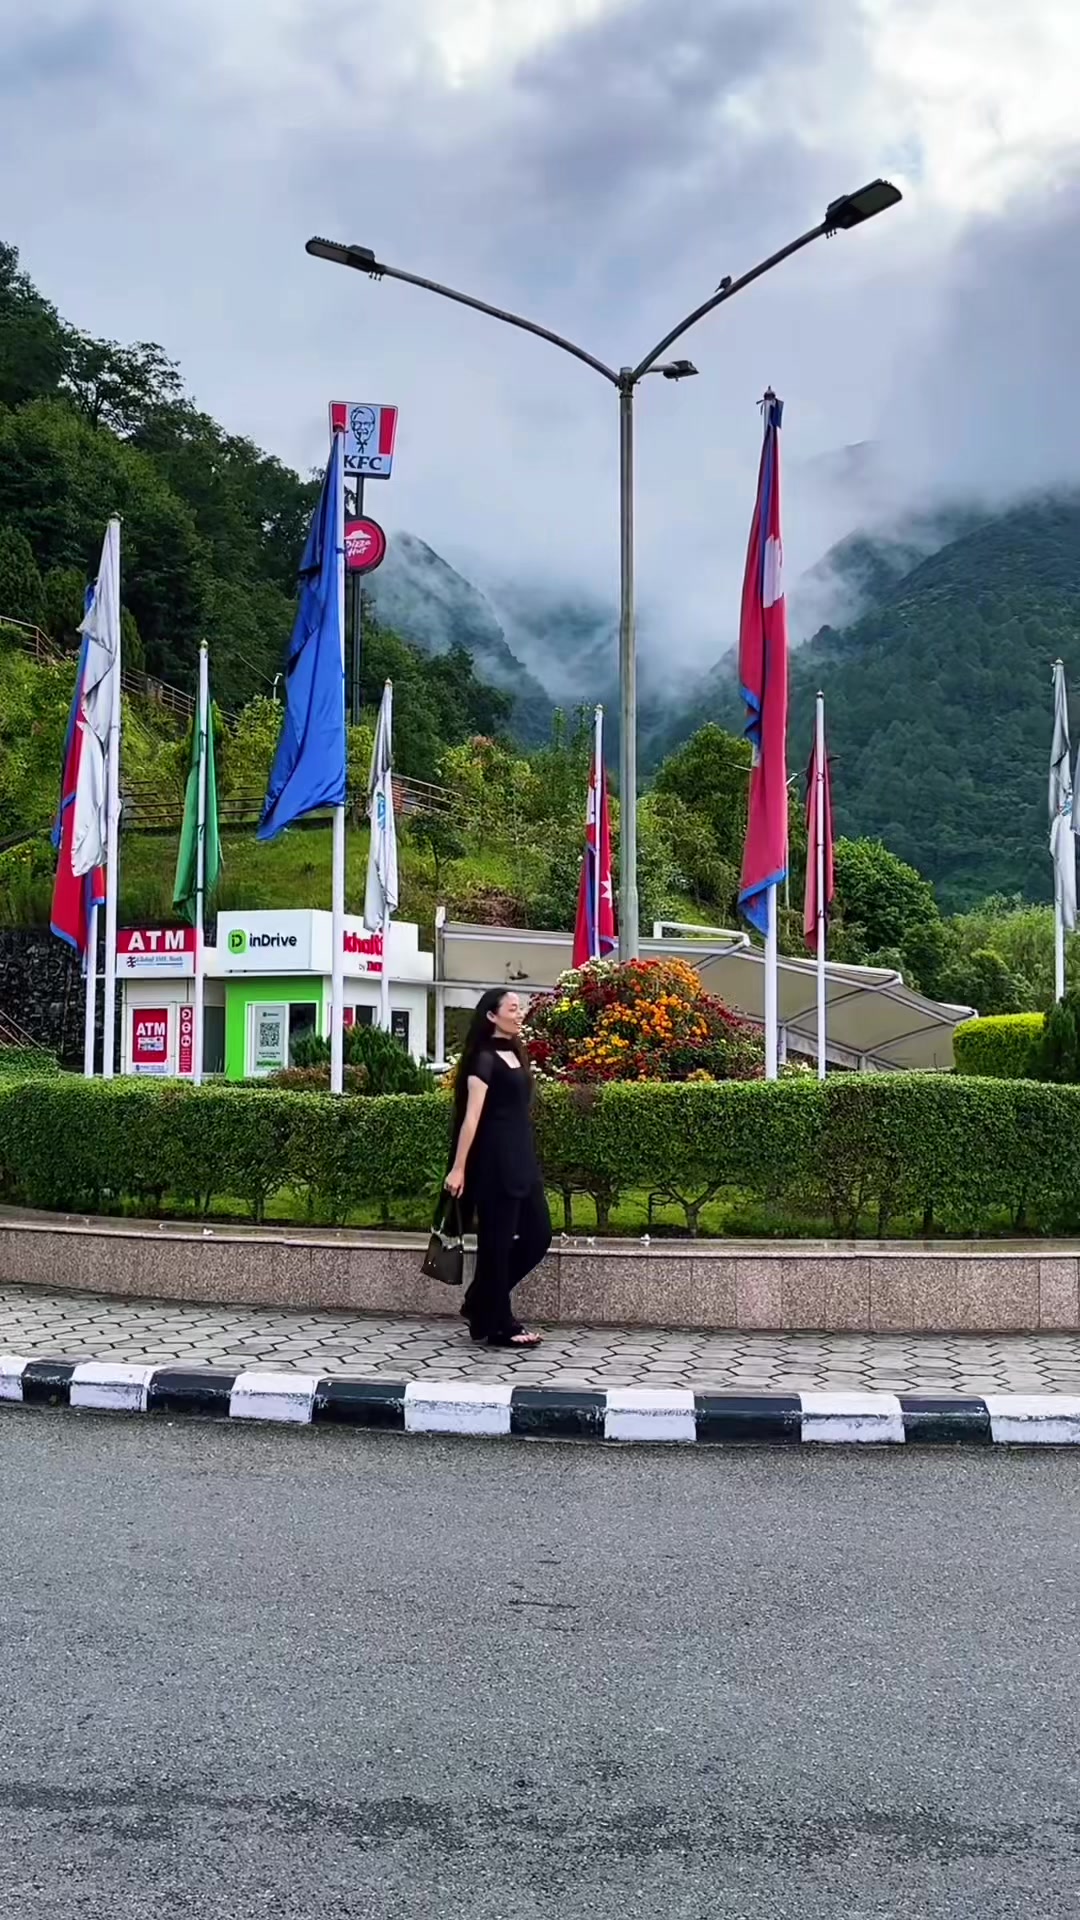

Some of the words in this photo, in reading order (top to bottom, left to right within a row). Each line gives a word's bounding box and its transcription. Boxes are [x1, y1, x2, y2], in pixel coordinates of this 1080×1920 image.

[344, 454, 382, 470] KFC
[128, 930, 185, 951] ATM
[249, 932, 298, 947] inDrive
[136, 1022, 166, 1036] ATM
